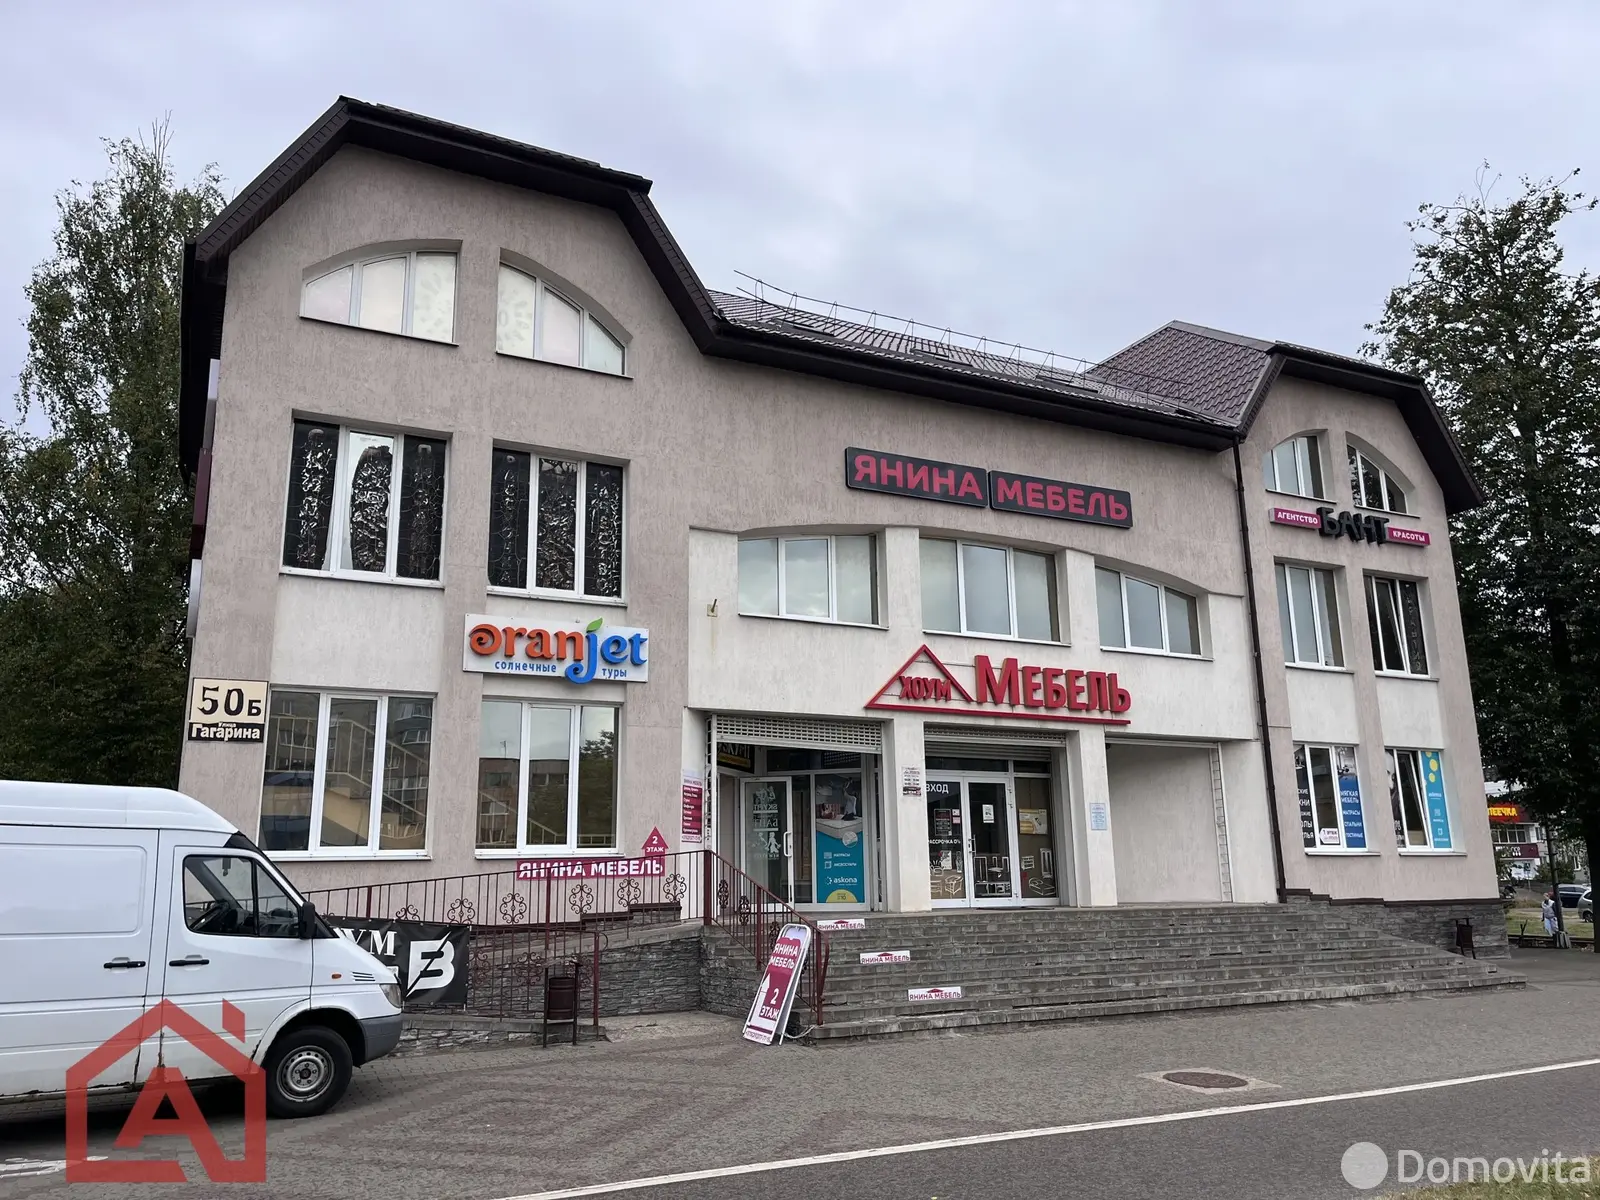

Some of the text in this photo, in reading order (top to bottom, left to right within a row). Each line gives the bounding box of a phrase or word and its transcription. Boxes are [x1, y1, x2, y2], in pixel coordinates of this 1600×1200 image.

[853, 454, 1128, 521] ЯНИНА МЕБЕЛЬ
[1277, 506, 1426, 545] АГЕНТСТВО БАНТ КРАСОТЫ
[494, 660, 627, 679] солнечные туры
[899, 675, 952, 701] ХОУМ
[191, 723, 261, 741] Гагарина
[652, 836, 658, 844] 2
[519, 859, 663, 878] ЯНИНА МЕБЕЛЬ
[833, 876, 858, 884] askona
[773, 943, 798, 957] ЯНИНА
[769, 955, 795, 969] МЕБЕЛЬ
[884, 955, 910, 963] МЕБЕЛЬ
[770, 988, 779, 1005] 2
[760, 1006, 780, 1020] ЭТАЖ
